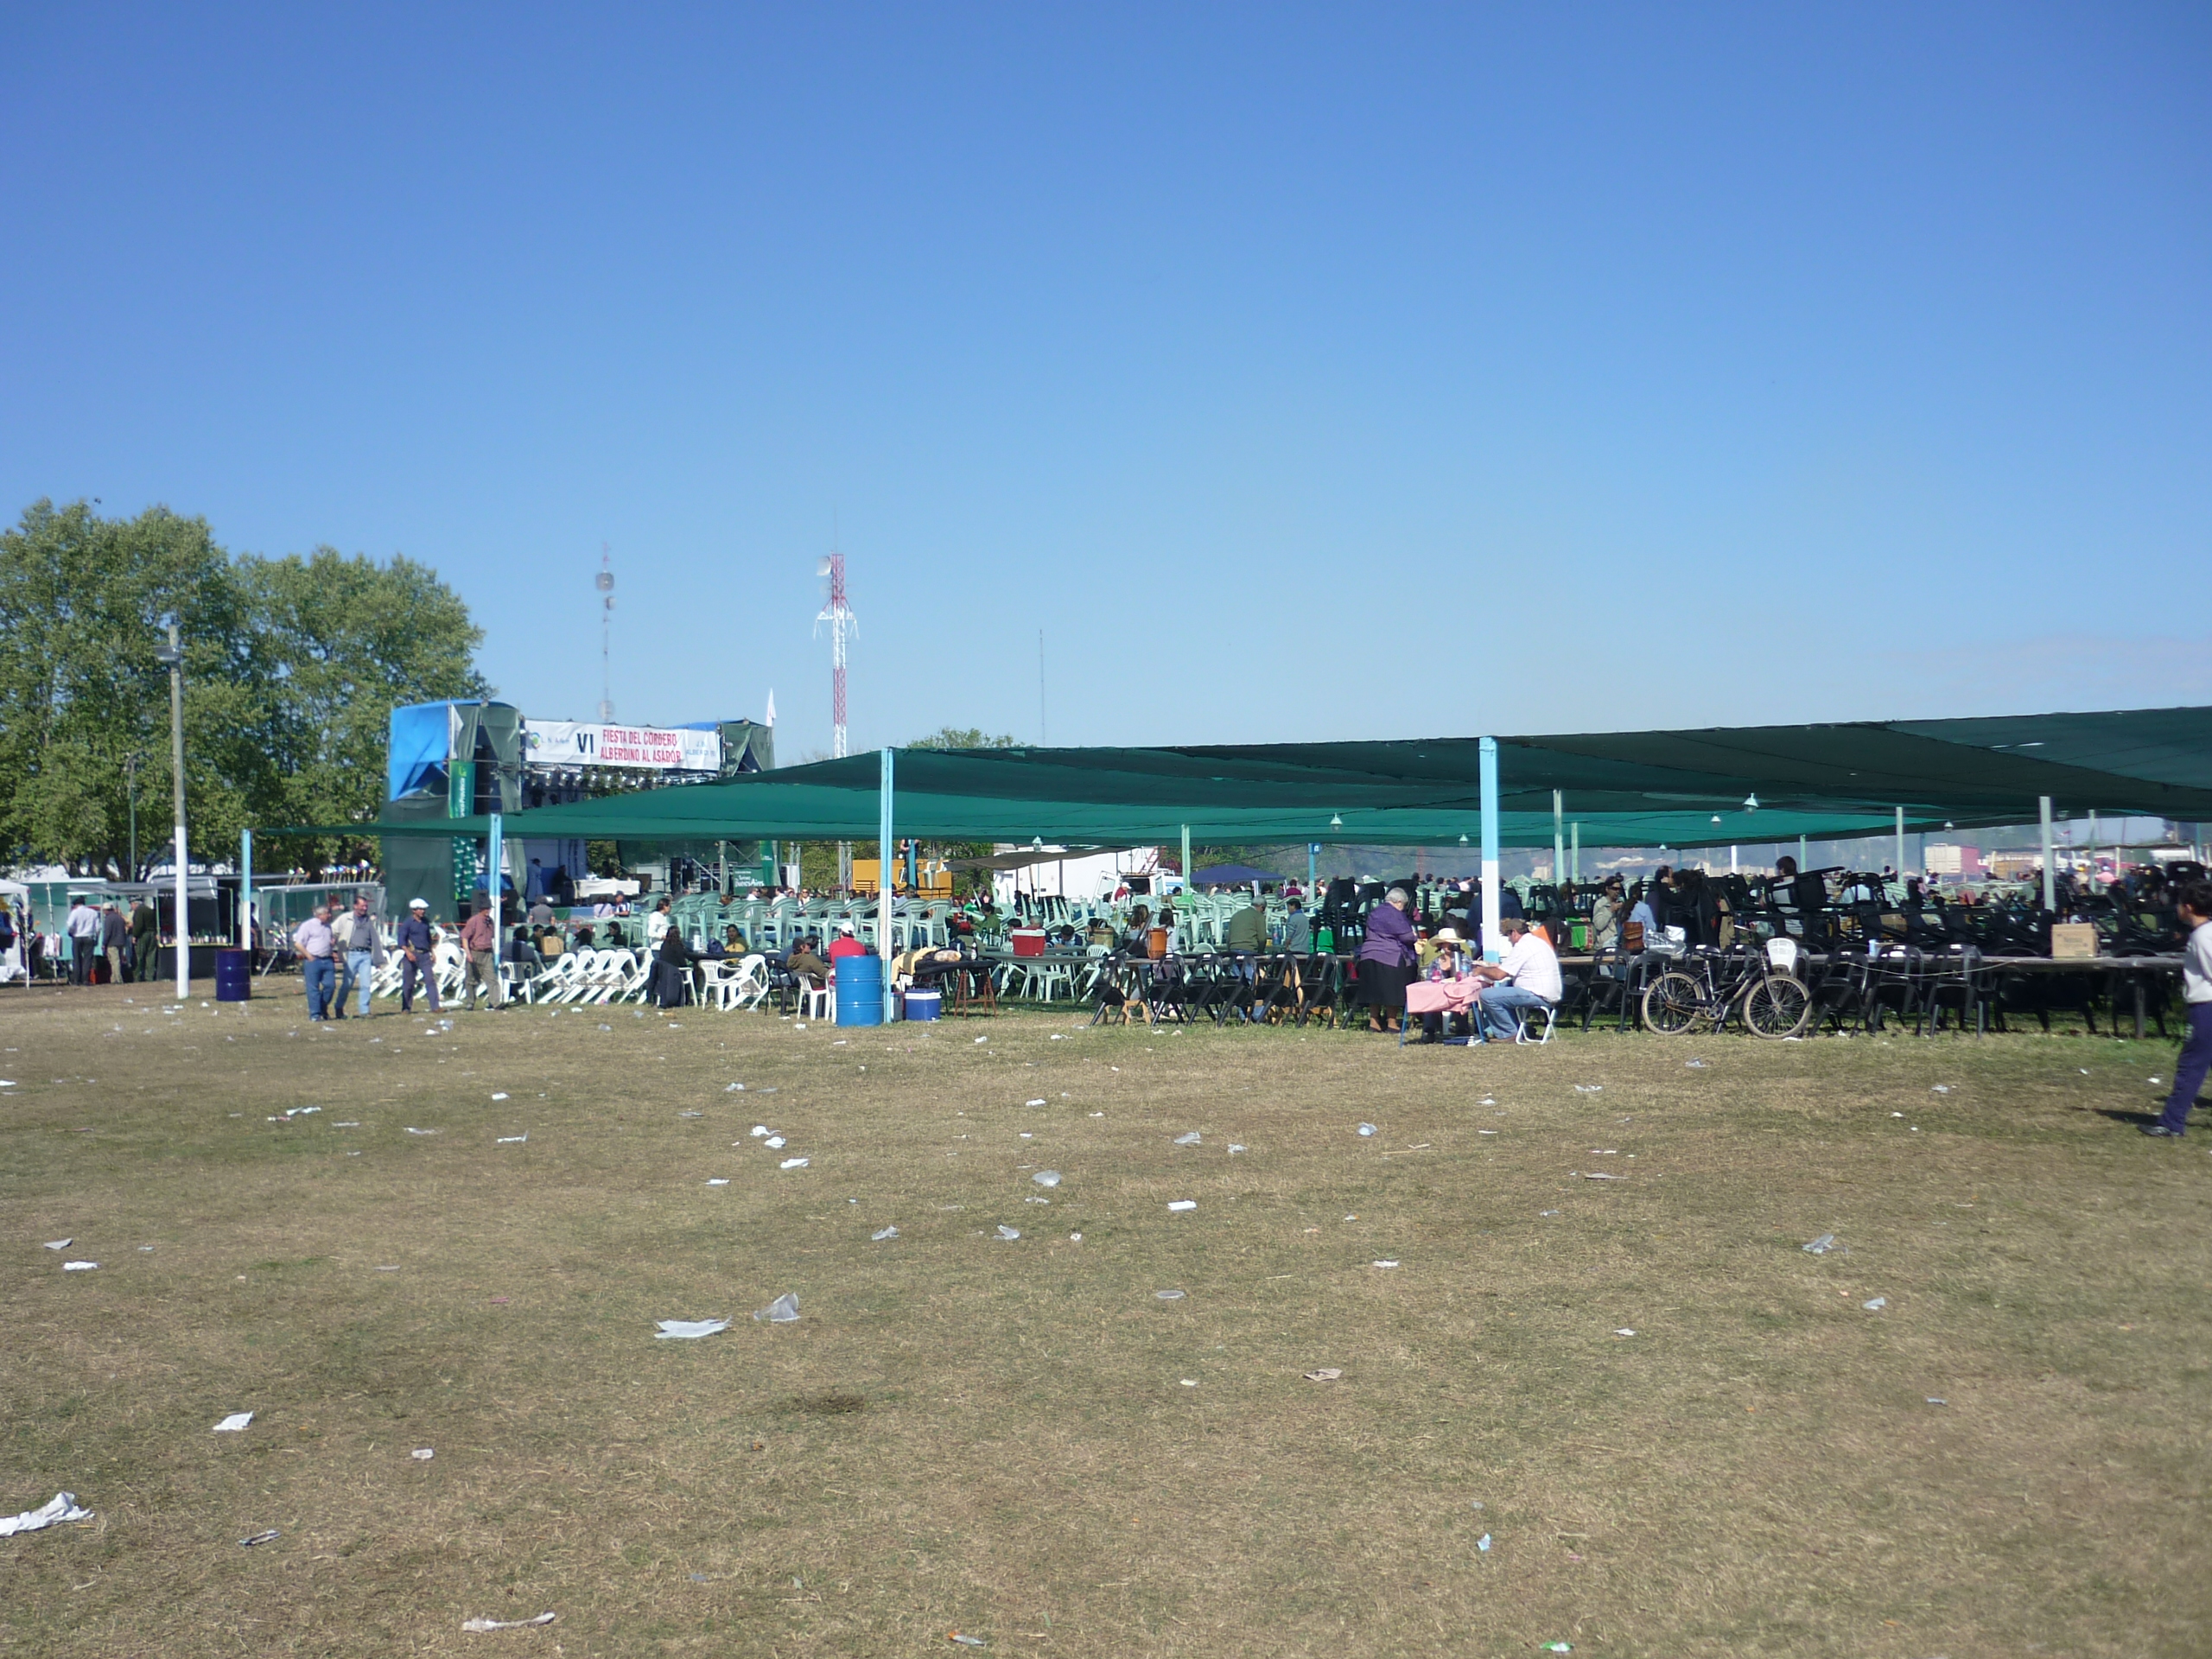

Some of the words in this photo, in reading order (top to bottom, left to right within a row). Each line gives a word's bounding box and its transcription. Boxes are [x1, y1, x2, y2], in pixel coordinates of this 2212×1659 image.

[576, 733, 594, 753] VI
[603, 728, 627, 744] FIESTA
[629, 731, 641, 745] DEL
[644, 732, 677, 747] CORDERO
[601, 747, 639, 762] ALBERDINO
[642, 749, 651, 762] AL
[652, 749, 681, 763] ASADOR
